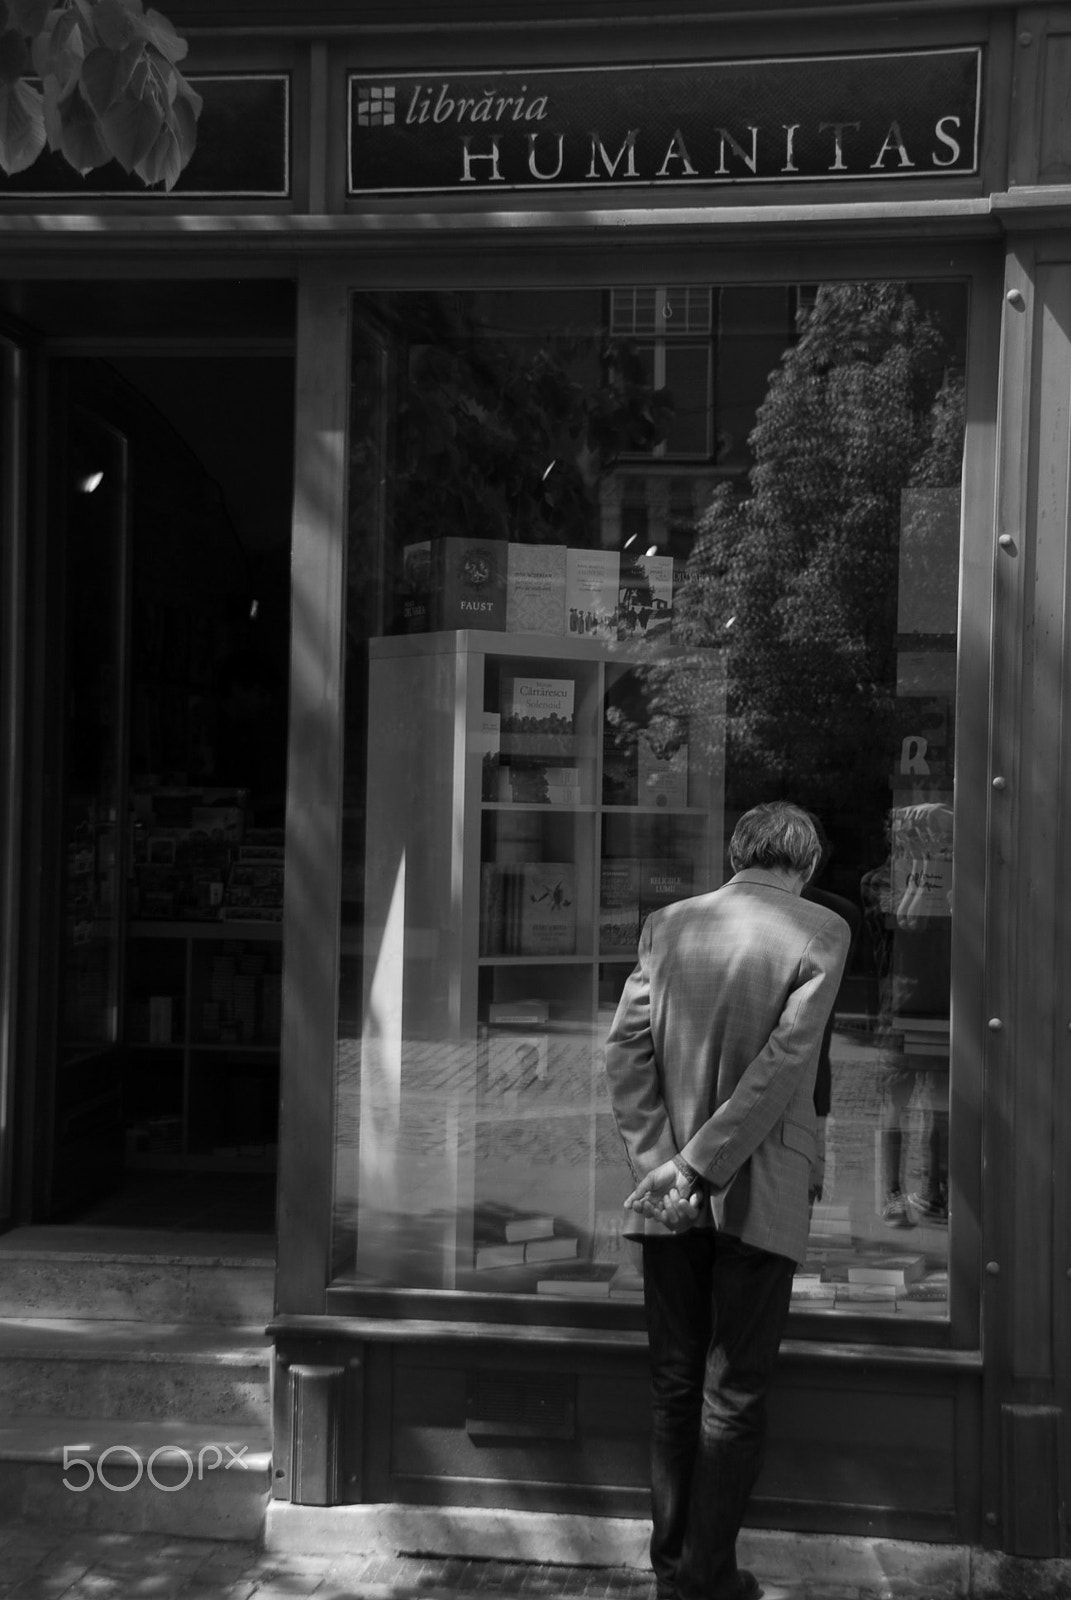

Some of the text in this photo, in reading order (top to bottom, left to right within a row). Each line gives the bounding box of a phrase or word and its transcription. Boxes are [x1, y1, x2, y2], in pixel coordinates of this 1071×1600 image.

[404, 85, 548, 125] librăria
[460, 115, 962, 182] HUMANITAS
[460, 601, 494, 611] FAUST
